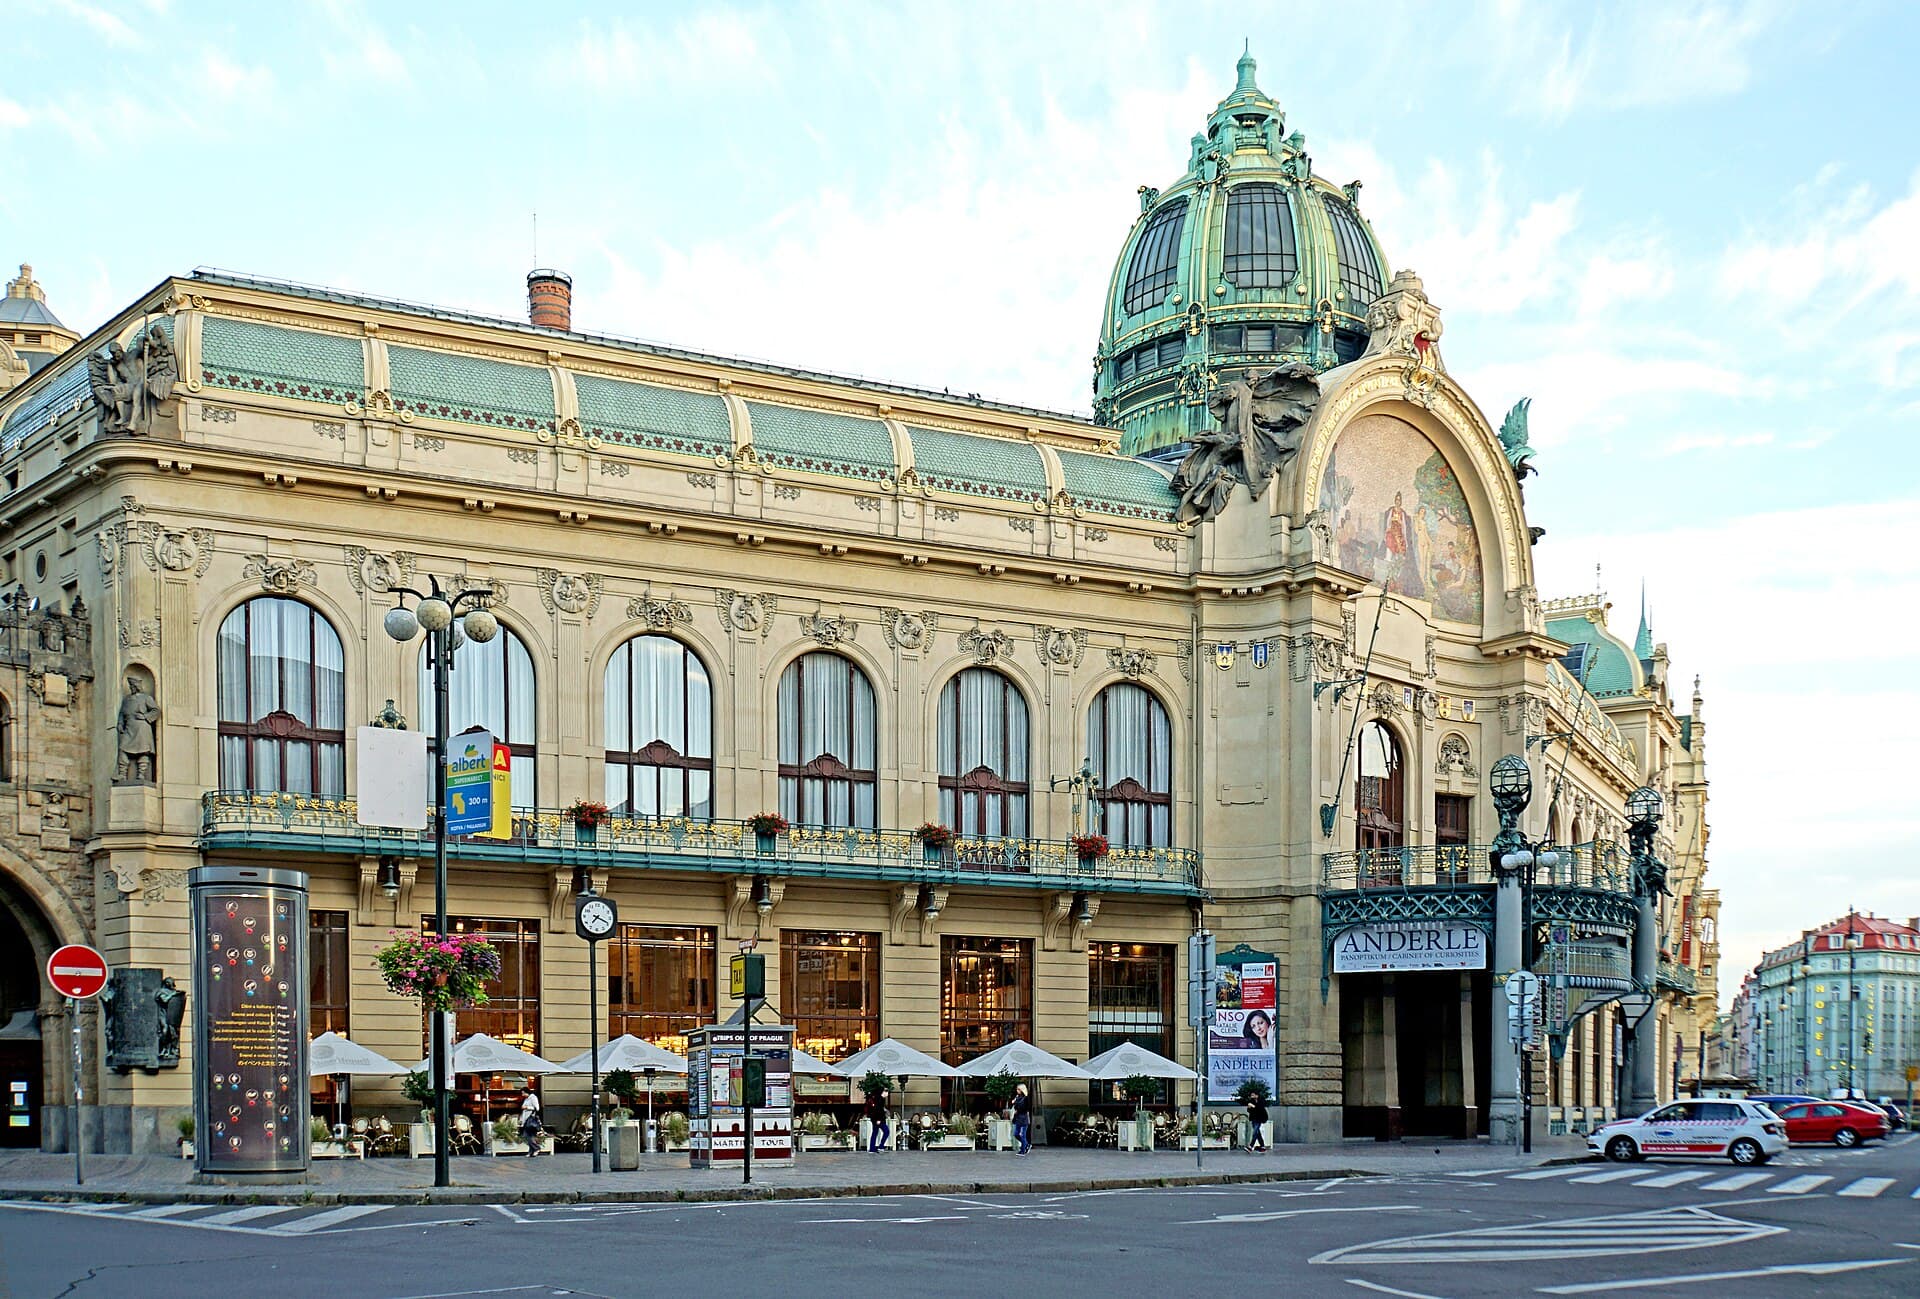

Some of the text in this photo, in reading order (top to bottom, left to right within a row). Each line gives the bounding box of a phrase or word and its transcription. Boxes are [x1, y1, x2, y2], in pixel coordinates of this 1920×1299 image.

[452, 754, 486, 773] albert
[494, 750, 507, 768] A
[468, 797, 481, 806] 300
[1342, 928, 1479, 953] ANDERLE
[1435, 951, 1480, 959] CURIOSITIES
[733, 968, 743, 985] TAXI
[1815, 984, 1825, 1057] HOTEL
[1212, 1059, 1273, 1070] ANDERLE
[713, 1139, 745, 1147] MARTI
